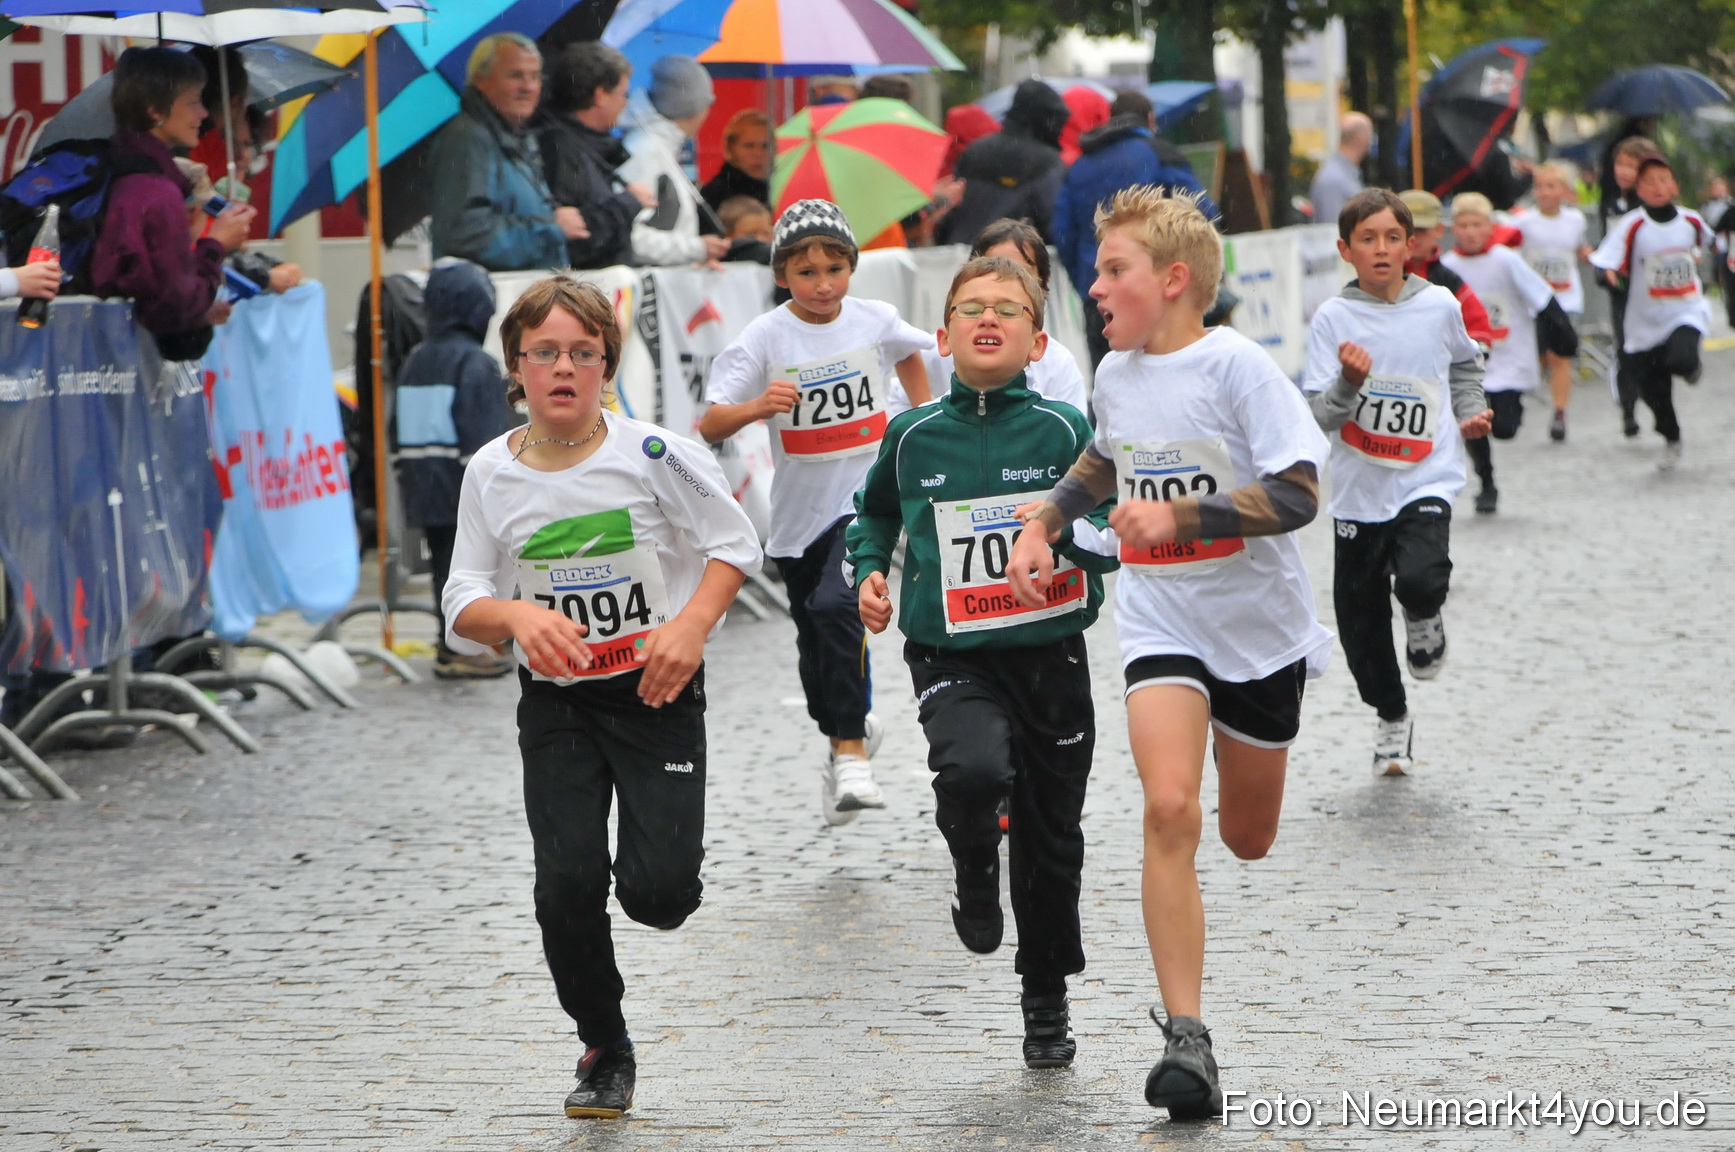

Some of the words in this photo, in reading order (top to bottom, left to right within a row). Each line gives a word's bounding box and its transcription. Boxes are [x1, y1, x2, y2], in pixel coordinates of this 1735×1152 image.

[799, 361, 848, 381] BOCK
[793, 376, 874, 426] 7294
[1355, 393, 1427, 436] 7130
[1362, 436, 1402, 456] David
[1133, 450, 1182, 466] BOCK
[666, 453, 709, 498] Bionorica
[920, 476, 942, 488] JAKO
[1002, 467, 1044, 482] Bergler
[1048, 466, 1060, 479] C.
[971, 502, 1033, 523] BOC
[550, 564, 613, 583] BOCK
[1056, 735, 1081, 746] JAKO
[664, 761, 690, 773] JAKO
